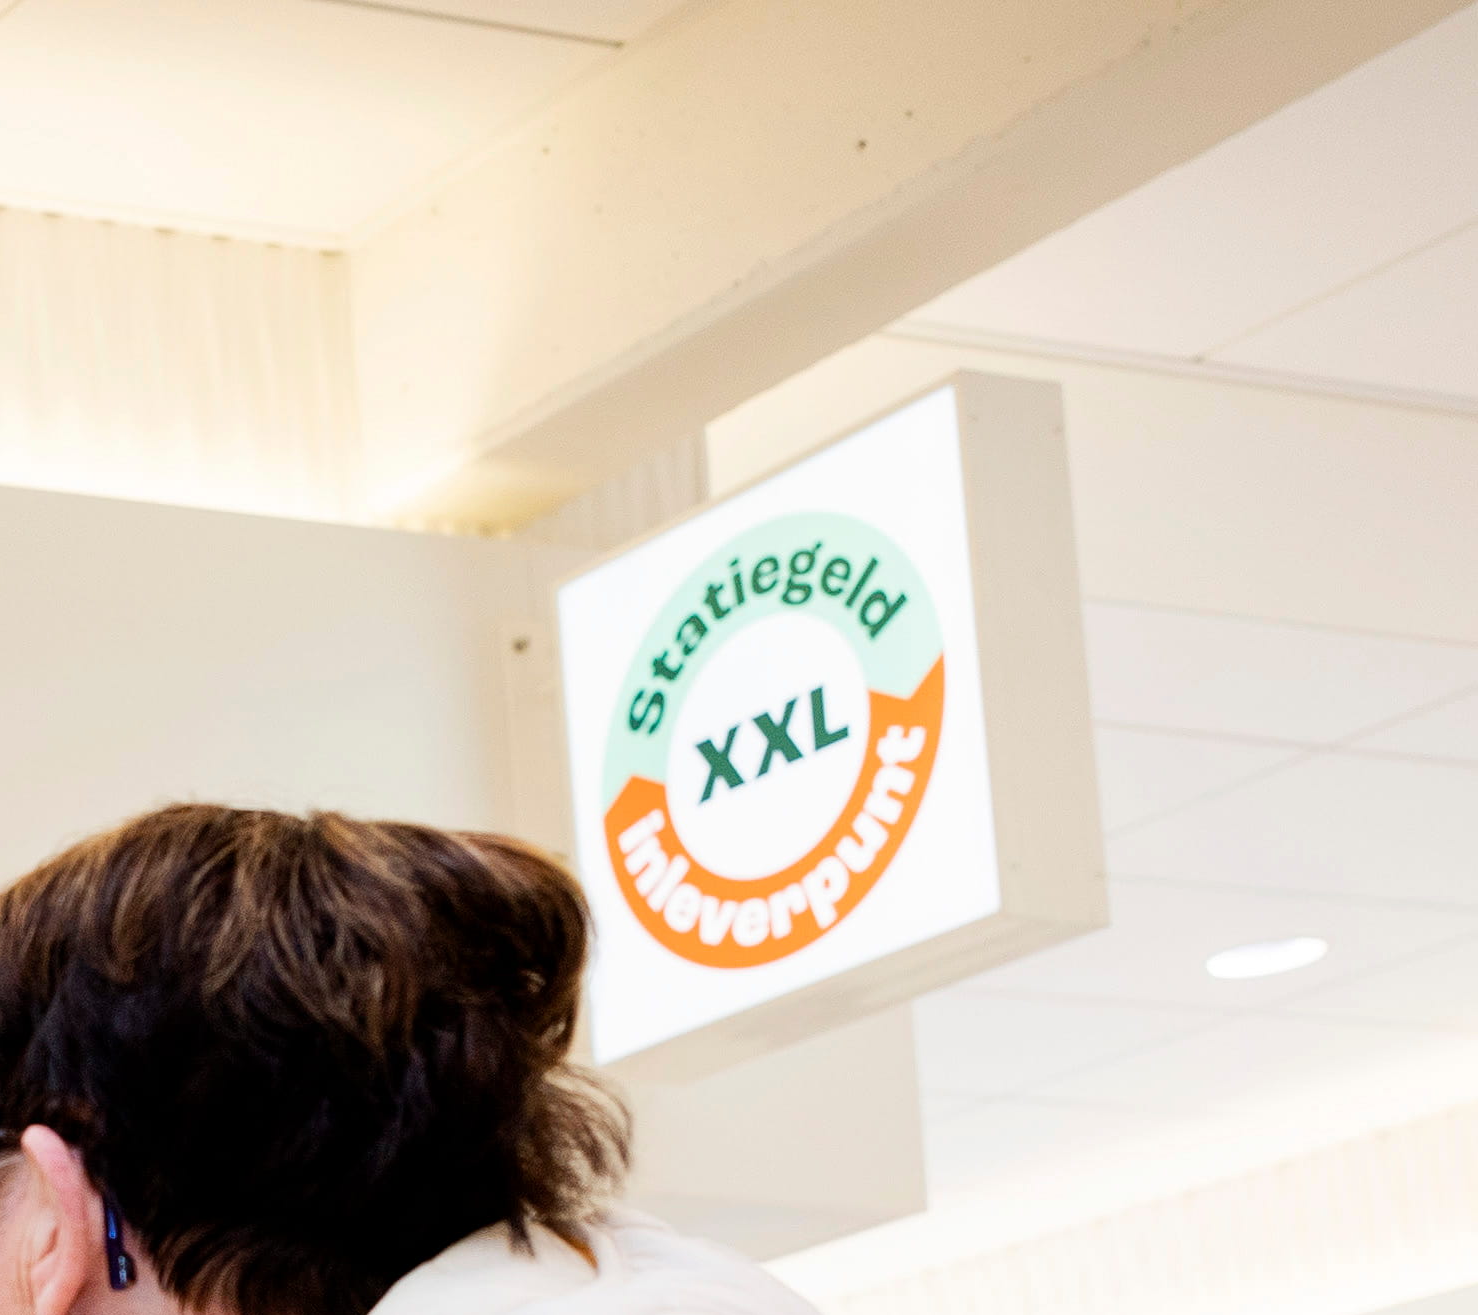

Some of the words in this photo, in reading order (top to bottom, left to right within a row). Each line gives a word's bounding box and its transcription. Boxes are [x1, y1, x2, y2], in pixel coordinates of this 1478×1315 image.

[628, 541, 907, 735] Statiegeld
[618, 724, 927, 947] inleverpunt
[695, 686, 849, 804] XXL
